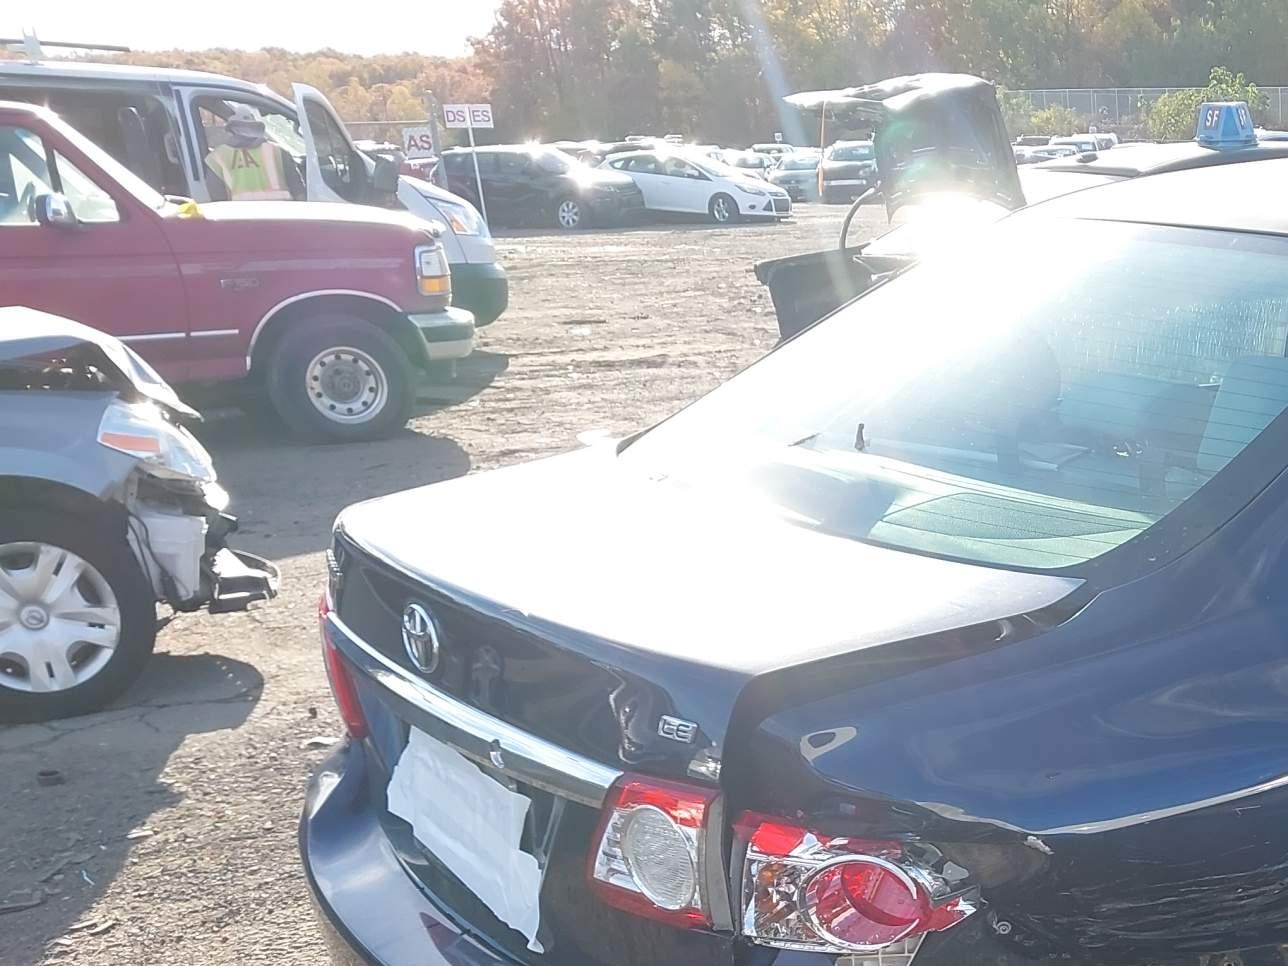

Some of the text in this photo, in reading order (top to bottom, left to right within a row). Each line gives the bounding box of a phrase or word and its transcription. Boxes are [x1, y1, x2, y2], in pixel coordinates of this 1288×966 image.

[445, 110, 466, 123] DS
[471, 110, 491, 123] ES
[1205, 108, 1220, 127] SF
[407, 134, 432, 151] AS
